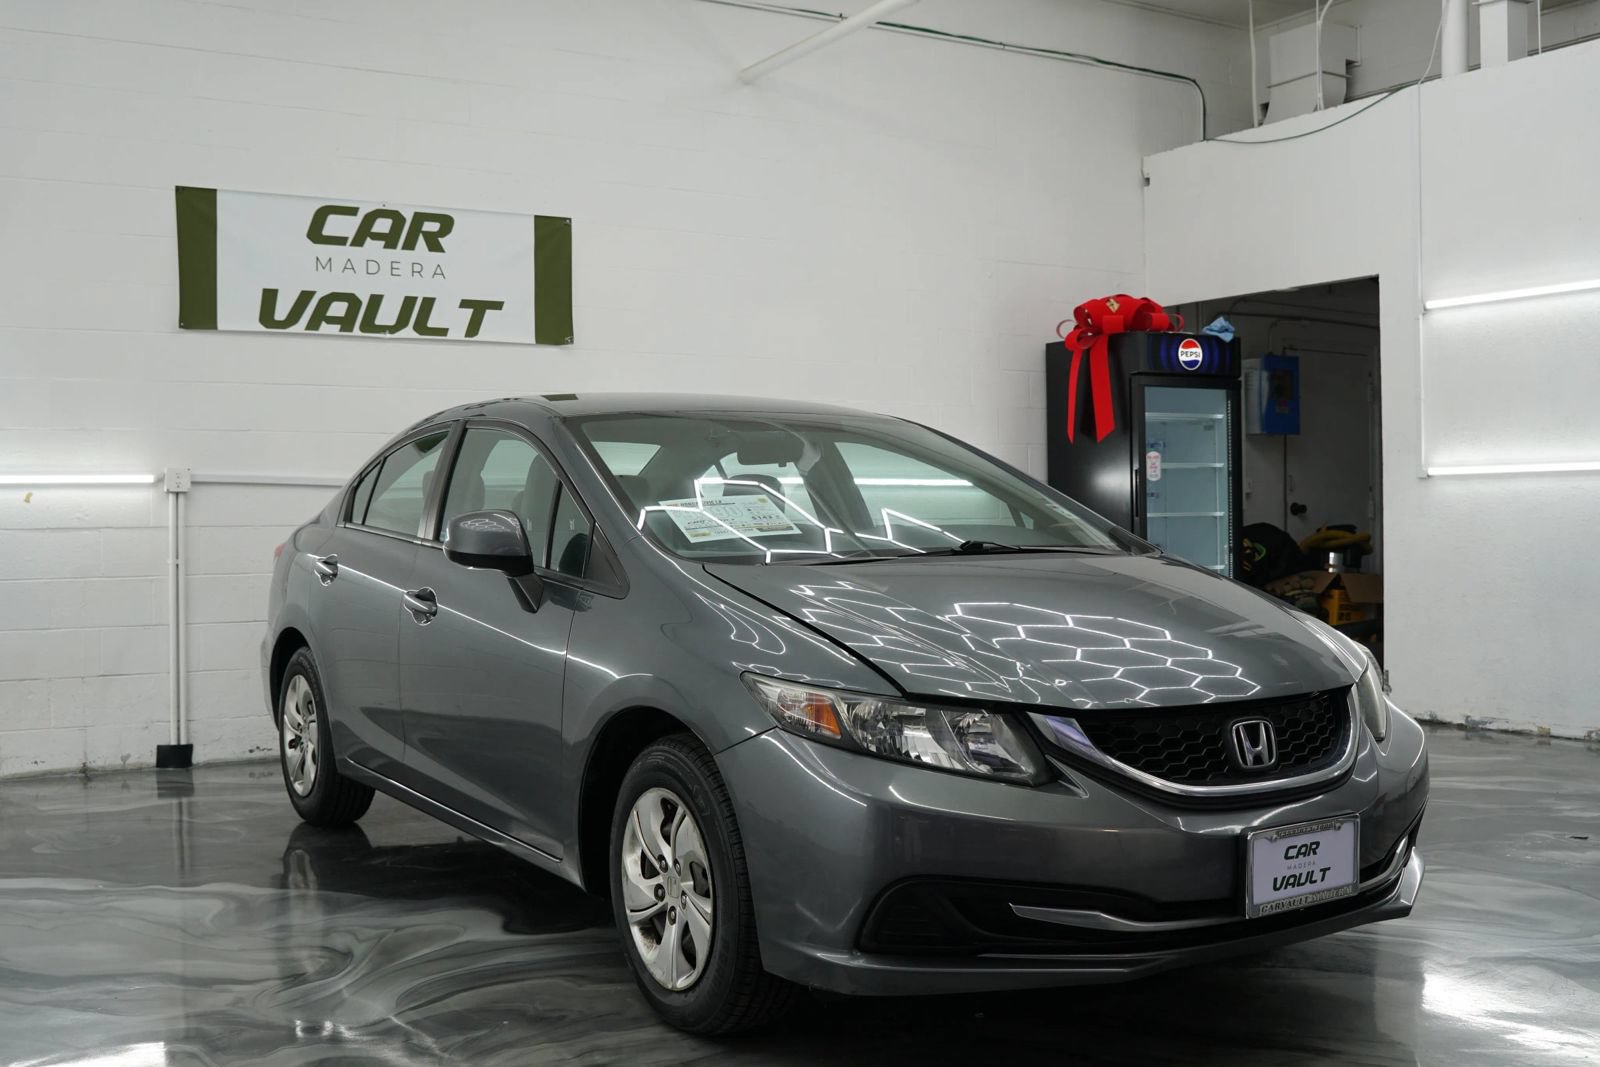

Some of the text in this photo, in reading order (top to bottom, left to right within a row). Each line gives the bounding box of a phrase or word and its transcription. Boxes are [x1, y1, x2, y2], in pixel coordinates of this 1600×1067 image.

[306, 205, 455, 253] CAR
[315, 256, 446, 280] MADERA
[258, 288, 504, 338] VAULT
[1180, 350, 1200, 358] PEPSI
[1283, 841, 1321, 860] CAR
[1287, 860, 1316, 870] MADERA
[1272, 866, 1331, 892] VAULT
